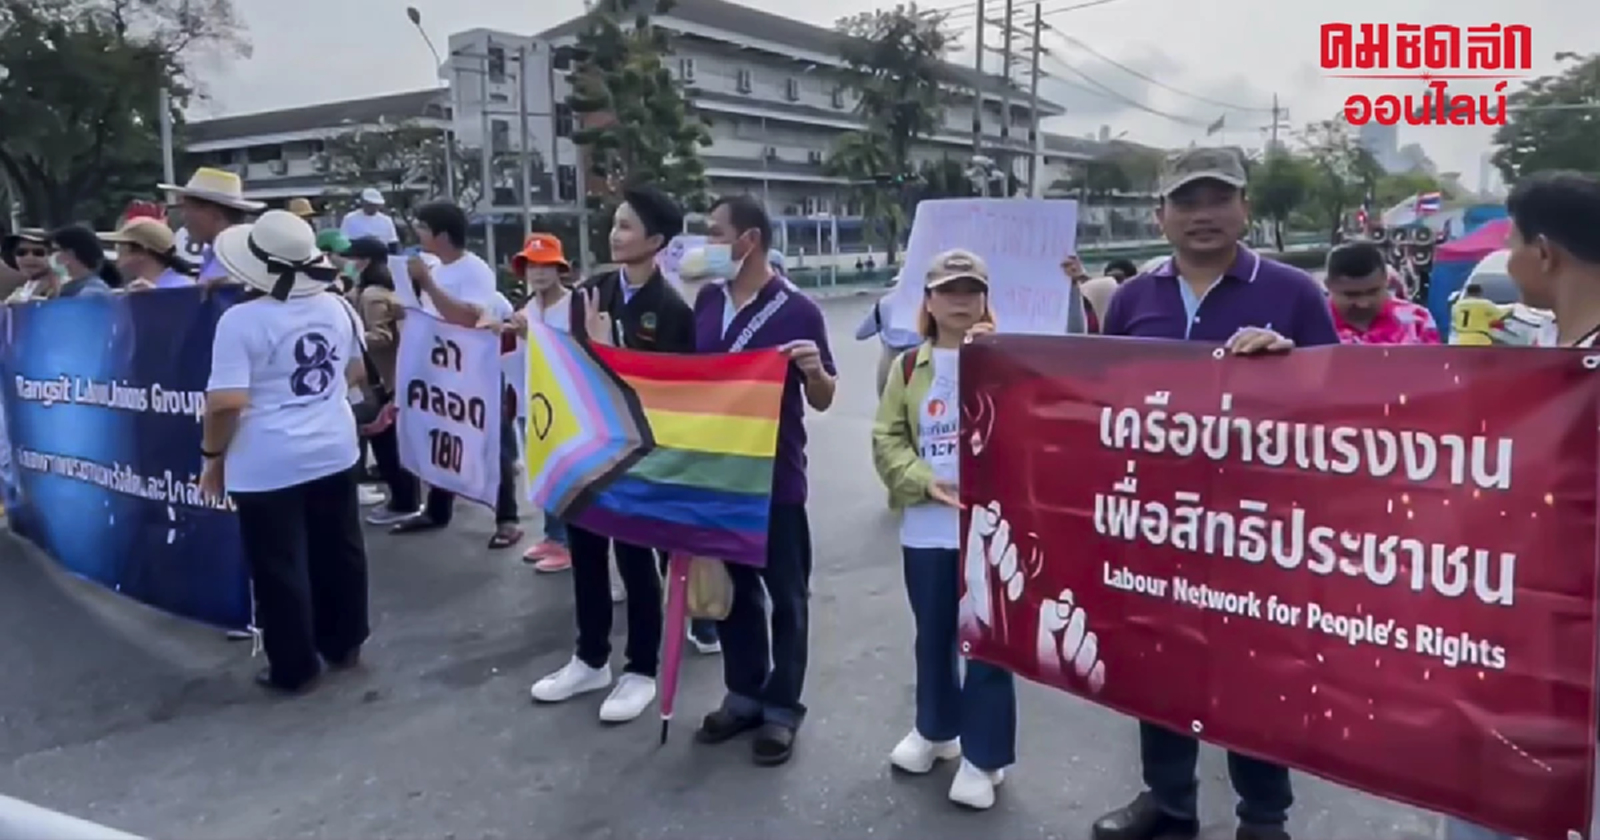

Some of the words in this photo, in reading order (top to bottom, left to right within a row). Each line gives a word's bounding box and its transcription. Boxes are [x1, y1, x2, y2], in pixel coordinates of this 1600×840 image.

[431, 335, 462, 372] ลา
[151, 383, 206, 423] Group
[407, 379, 486, 431] คลอด
[428, 428, 464, 474] 180
[1100, 391, 1513, 489] เครือข่ายแรงงาน
[1094, 460, 1516, 605] เพื่อสิทธิประชาชน
[1103, 561, 1168, 598] Labour
[1173, 577, 1261, 619] Network
[1266, 595, 1300, 627] for
[1307, 603, 1409, 649] People's
[1416, 625, 1506, 669] Rights
